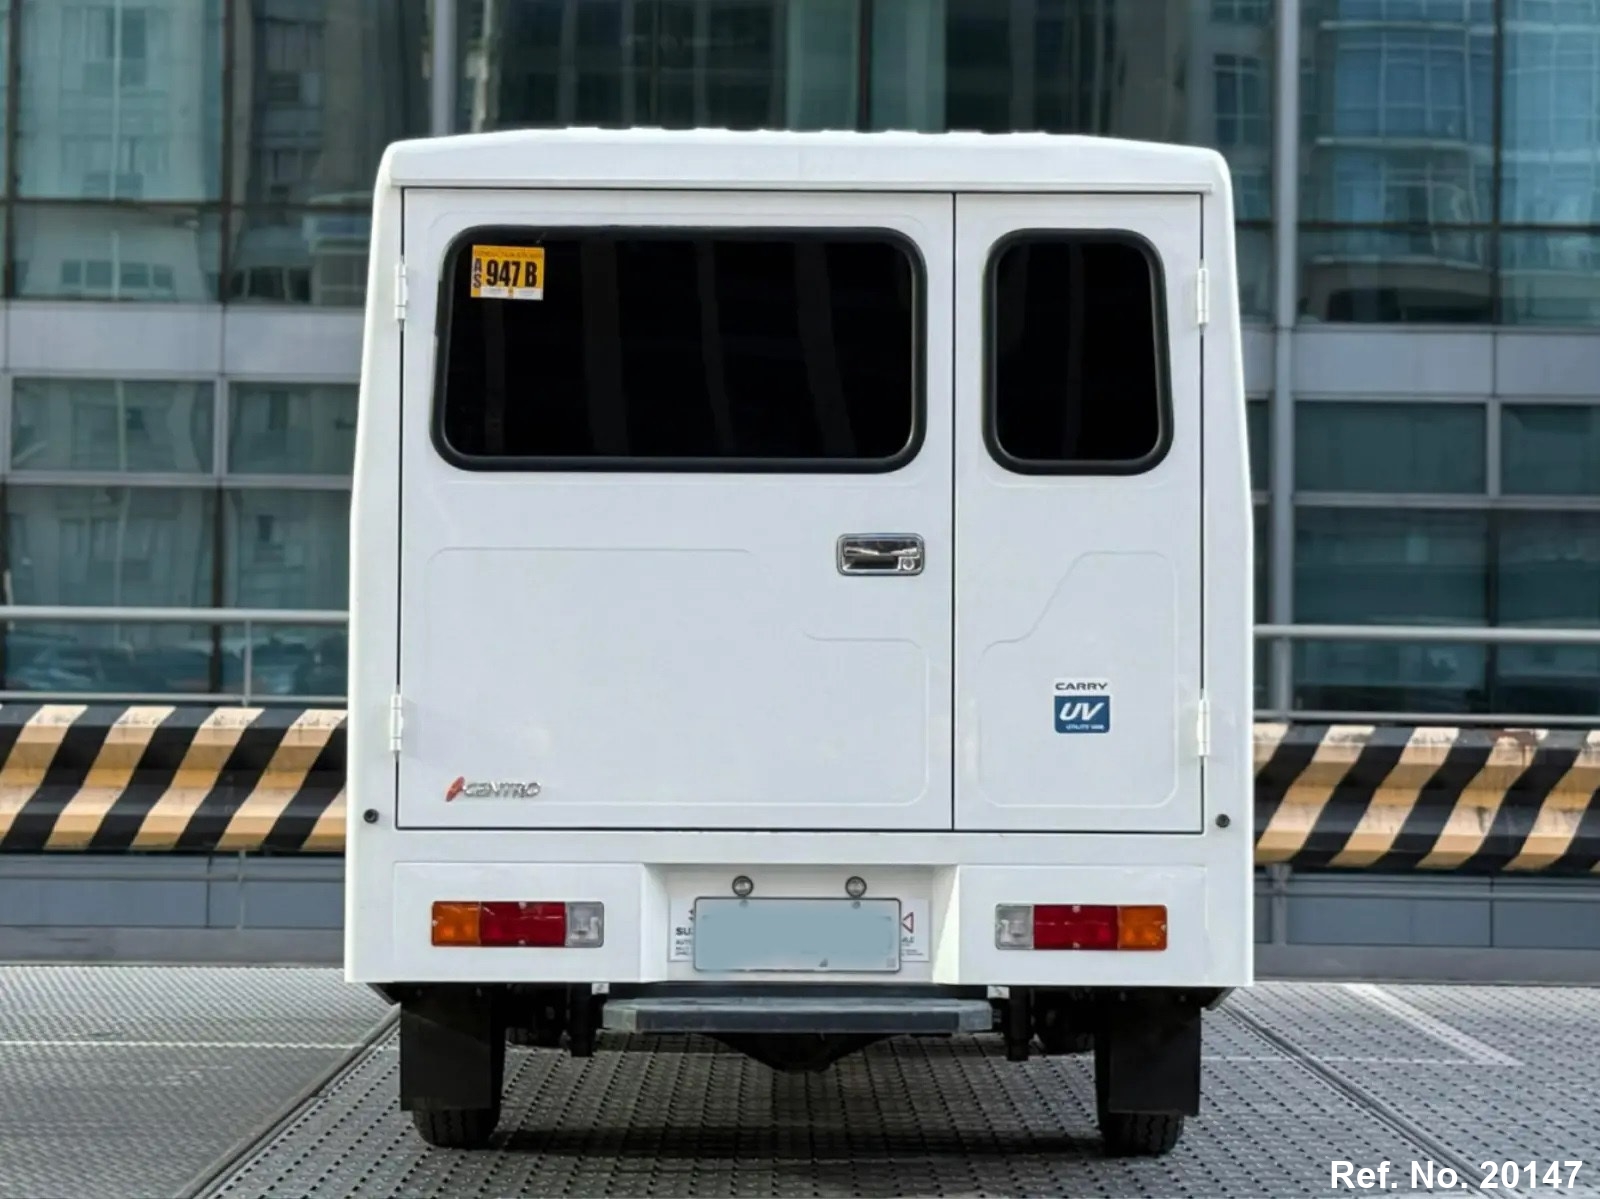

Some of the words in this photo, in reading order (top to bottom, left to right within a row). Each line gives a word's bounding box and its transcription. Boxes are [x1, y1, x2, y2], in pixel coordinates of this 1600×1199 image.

[486, 259, 521, 287] 947
[525, 261, 538, 288] B
[1055, 682, 1108, 691] CARRY
[1059, 702, 1105, 721] UV
[464, 782, 541, 798] CENTRO
